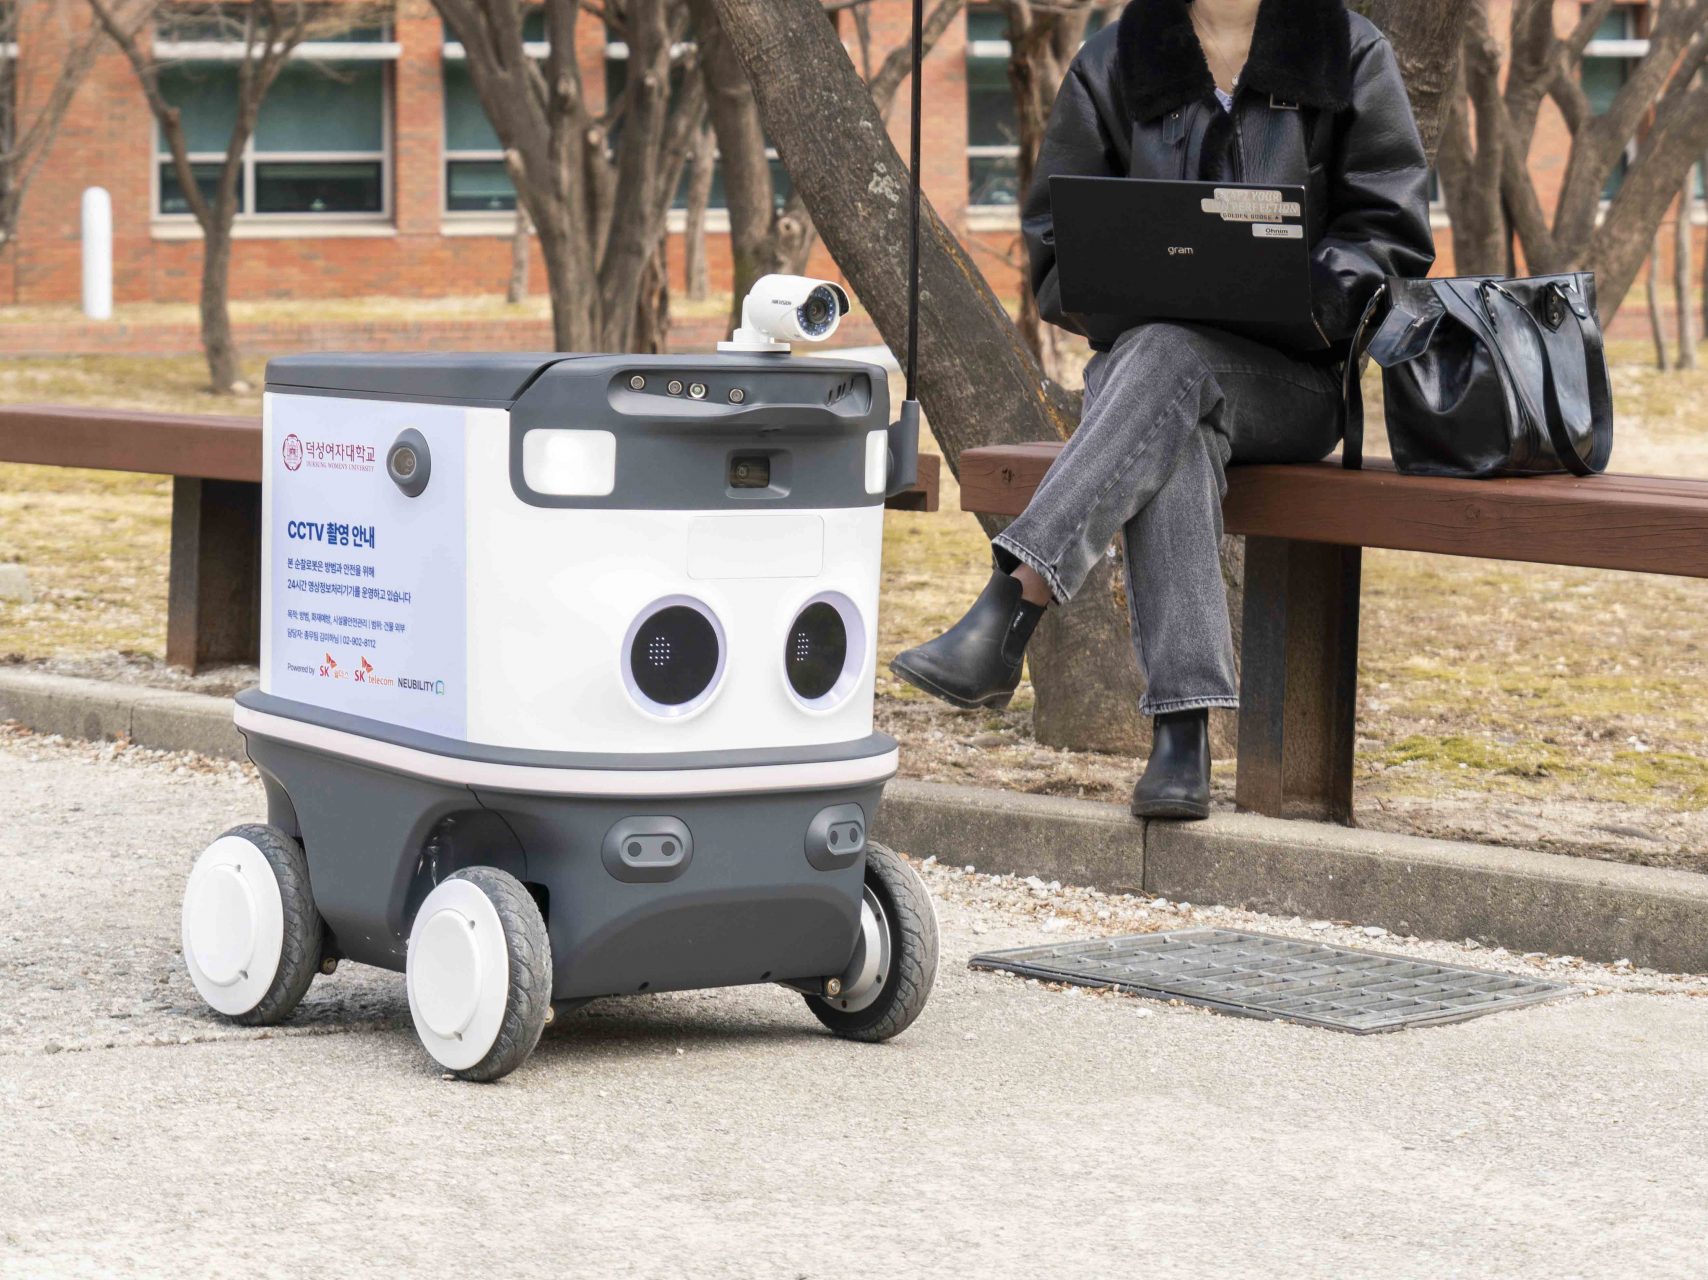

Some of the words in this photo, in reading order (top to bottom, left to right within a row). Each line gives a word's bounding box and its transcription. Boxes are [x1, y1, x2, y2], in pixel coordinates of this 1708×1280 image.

[1168, 246, 1194, 255] gram
[305, 441, 375, 463] 덕성여자대학교
[287, 520, 324, 541] CCTV
[327, 522, 349, 546] 촬영
[351, 524, 375, 549] 안내
[287, 558, 294, 569] 본
[295, 558, 323, 573] 순찰로봇은
[324, 562, 342, 575] 방범과
[343, 564, 361, 577] 안전을
[363, 566, 375, 578] 위해
[287, 578, 307, 591] 24시간
[308, 580, 360, 598] 영상정보처리기기를
[361, 586, 386, 600] 운영하고
[387, 590, 411, 604] 있습니다
[287, 662, 308, 673] Powered
[309, 664, 315, 676] by
[320, 665, 329, 678] SK
[354, 669, 365, 683] SK
[368, 674, 394, 686] telecom
[397, 677, 434, 692] NEUBILITY
